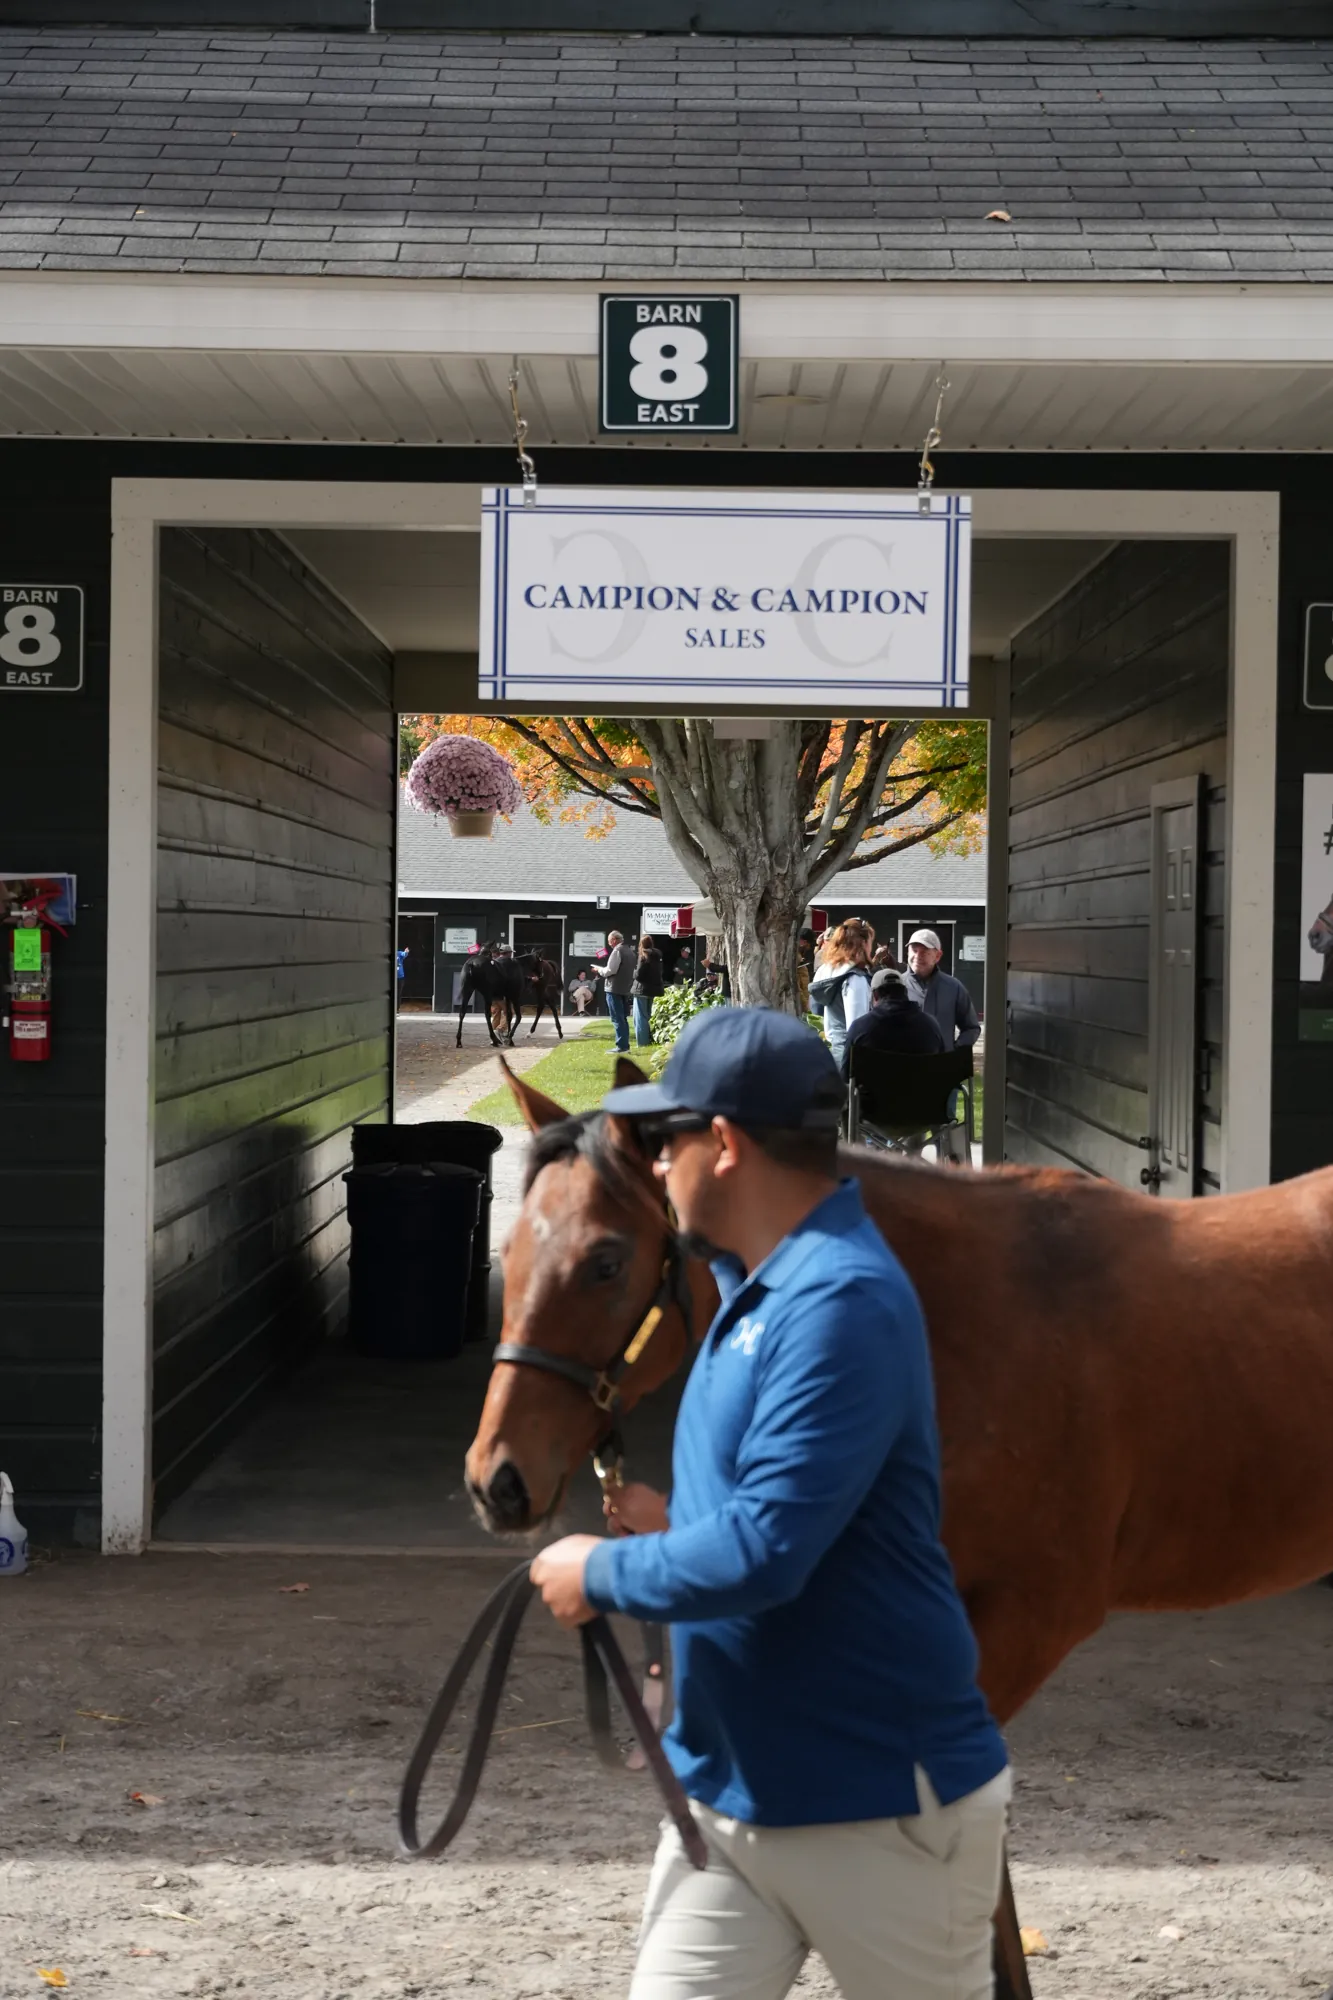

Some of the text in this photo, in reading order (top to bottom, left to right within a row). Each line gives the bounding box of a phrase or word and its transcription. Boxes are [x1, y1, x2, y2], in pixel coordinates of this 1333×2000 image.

[636, 304, 702, 323] BARN
[629, 325, 708, 401] 8
[637, 404, 700, 422] EAST
[3, 589, 59, 603] BARN
[524, 584, 929, 615] CAMPION & CAMPION
[0, 604, 62, 667] 8
[684, 627, 766, 649] SALES
[6, 671, 53, 685] EAST
